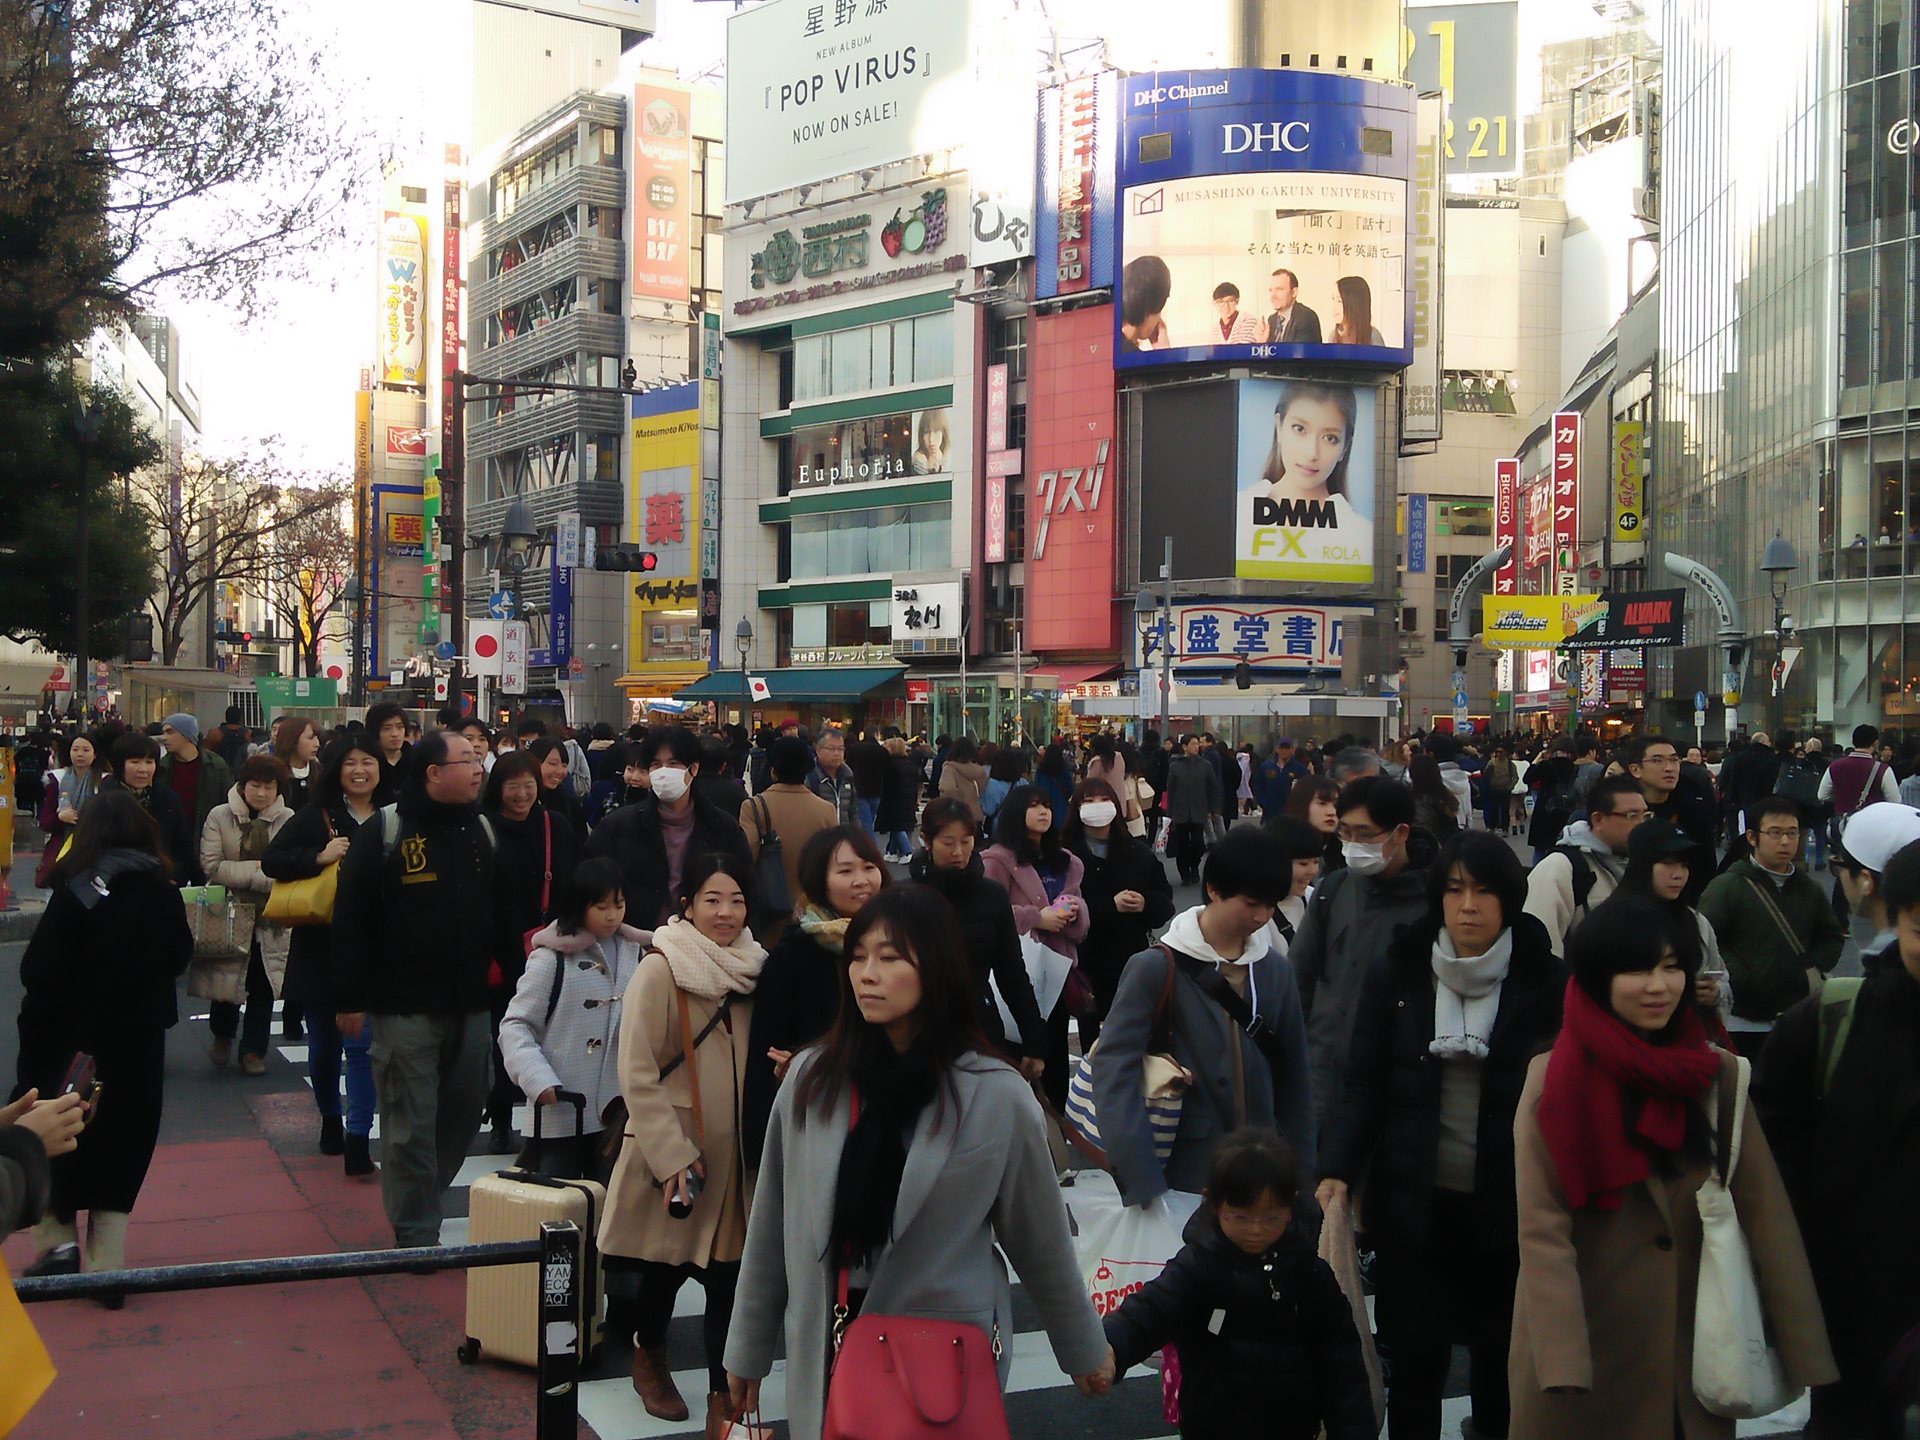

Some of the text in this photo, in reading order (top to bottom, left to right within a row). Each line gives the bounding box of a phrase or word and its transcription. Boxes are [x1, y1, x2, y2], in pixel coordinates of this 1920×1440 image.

[815, 34, 873, 60] NEW ALBUM
[1134, 80, 1229, 107] DHC Channel
[792, 100, 899, 145] NOW ON SALE!
[1221, 121, 1311, 154] DHC
[1467, 115, 1508, 158] 21
[1174, 185, 1397, 204] MUSASHINO GAKUIN UNIVERSITY
[1302, 214, 1393, 234] 「聞く」 「話す」
[801, 228, 871, 278] 西村
[1247, 241, 1391, 259] そんな当たり前を英語で
[1413, 256, 1431, 348] neon
[1250, 345, 1278, 358] DHC
[635, 426, 678, 439] Matsumoto
[798, 454, 905, 487] Euphoria
[1555, 427, 1575, 521] カラオケ
[1032, 438, 1111, 560] クスリ
[1252, 496, 1339, 529] DMM
[1500, 473, 1510, 525] BIG ECHO
[394, 517, 422, 541] 薬
[645, 491, 685, 546] 薬
[1619, 516, 1637, 528] 4F
[566, 516, 577, 563] 渋谷駅前
[1251, 528, 1361, 560] FX ROLA
[903, 603, 941, 630] 松川
[557, 612, 565, 655] みずほ銀行
[504, 627, 518, 687] 道玄坂
[792, 650, 891, 662] 渋谷西村 フルーツパーラー
[1584, 655, 1595, 697] ラーメン
